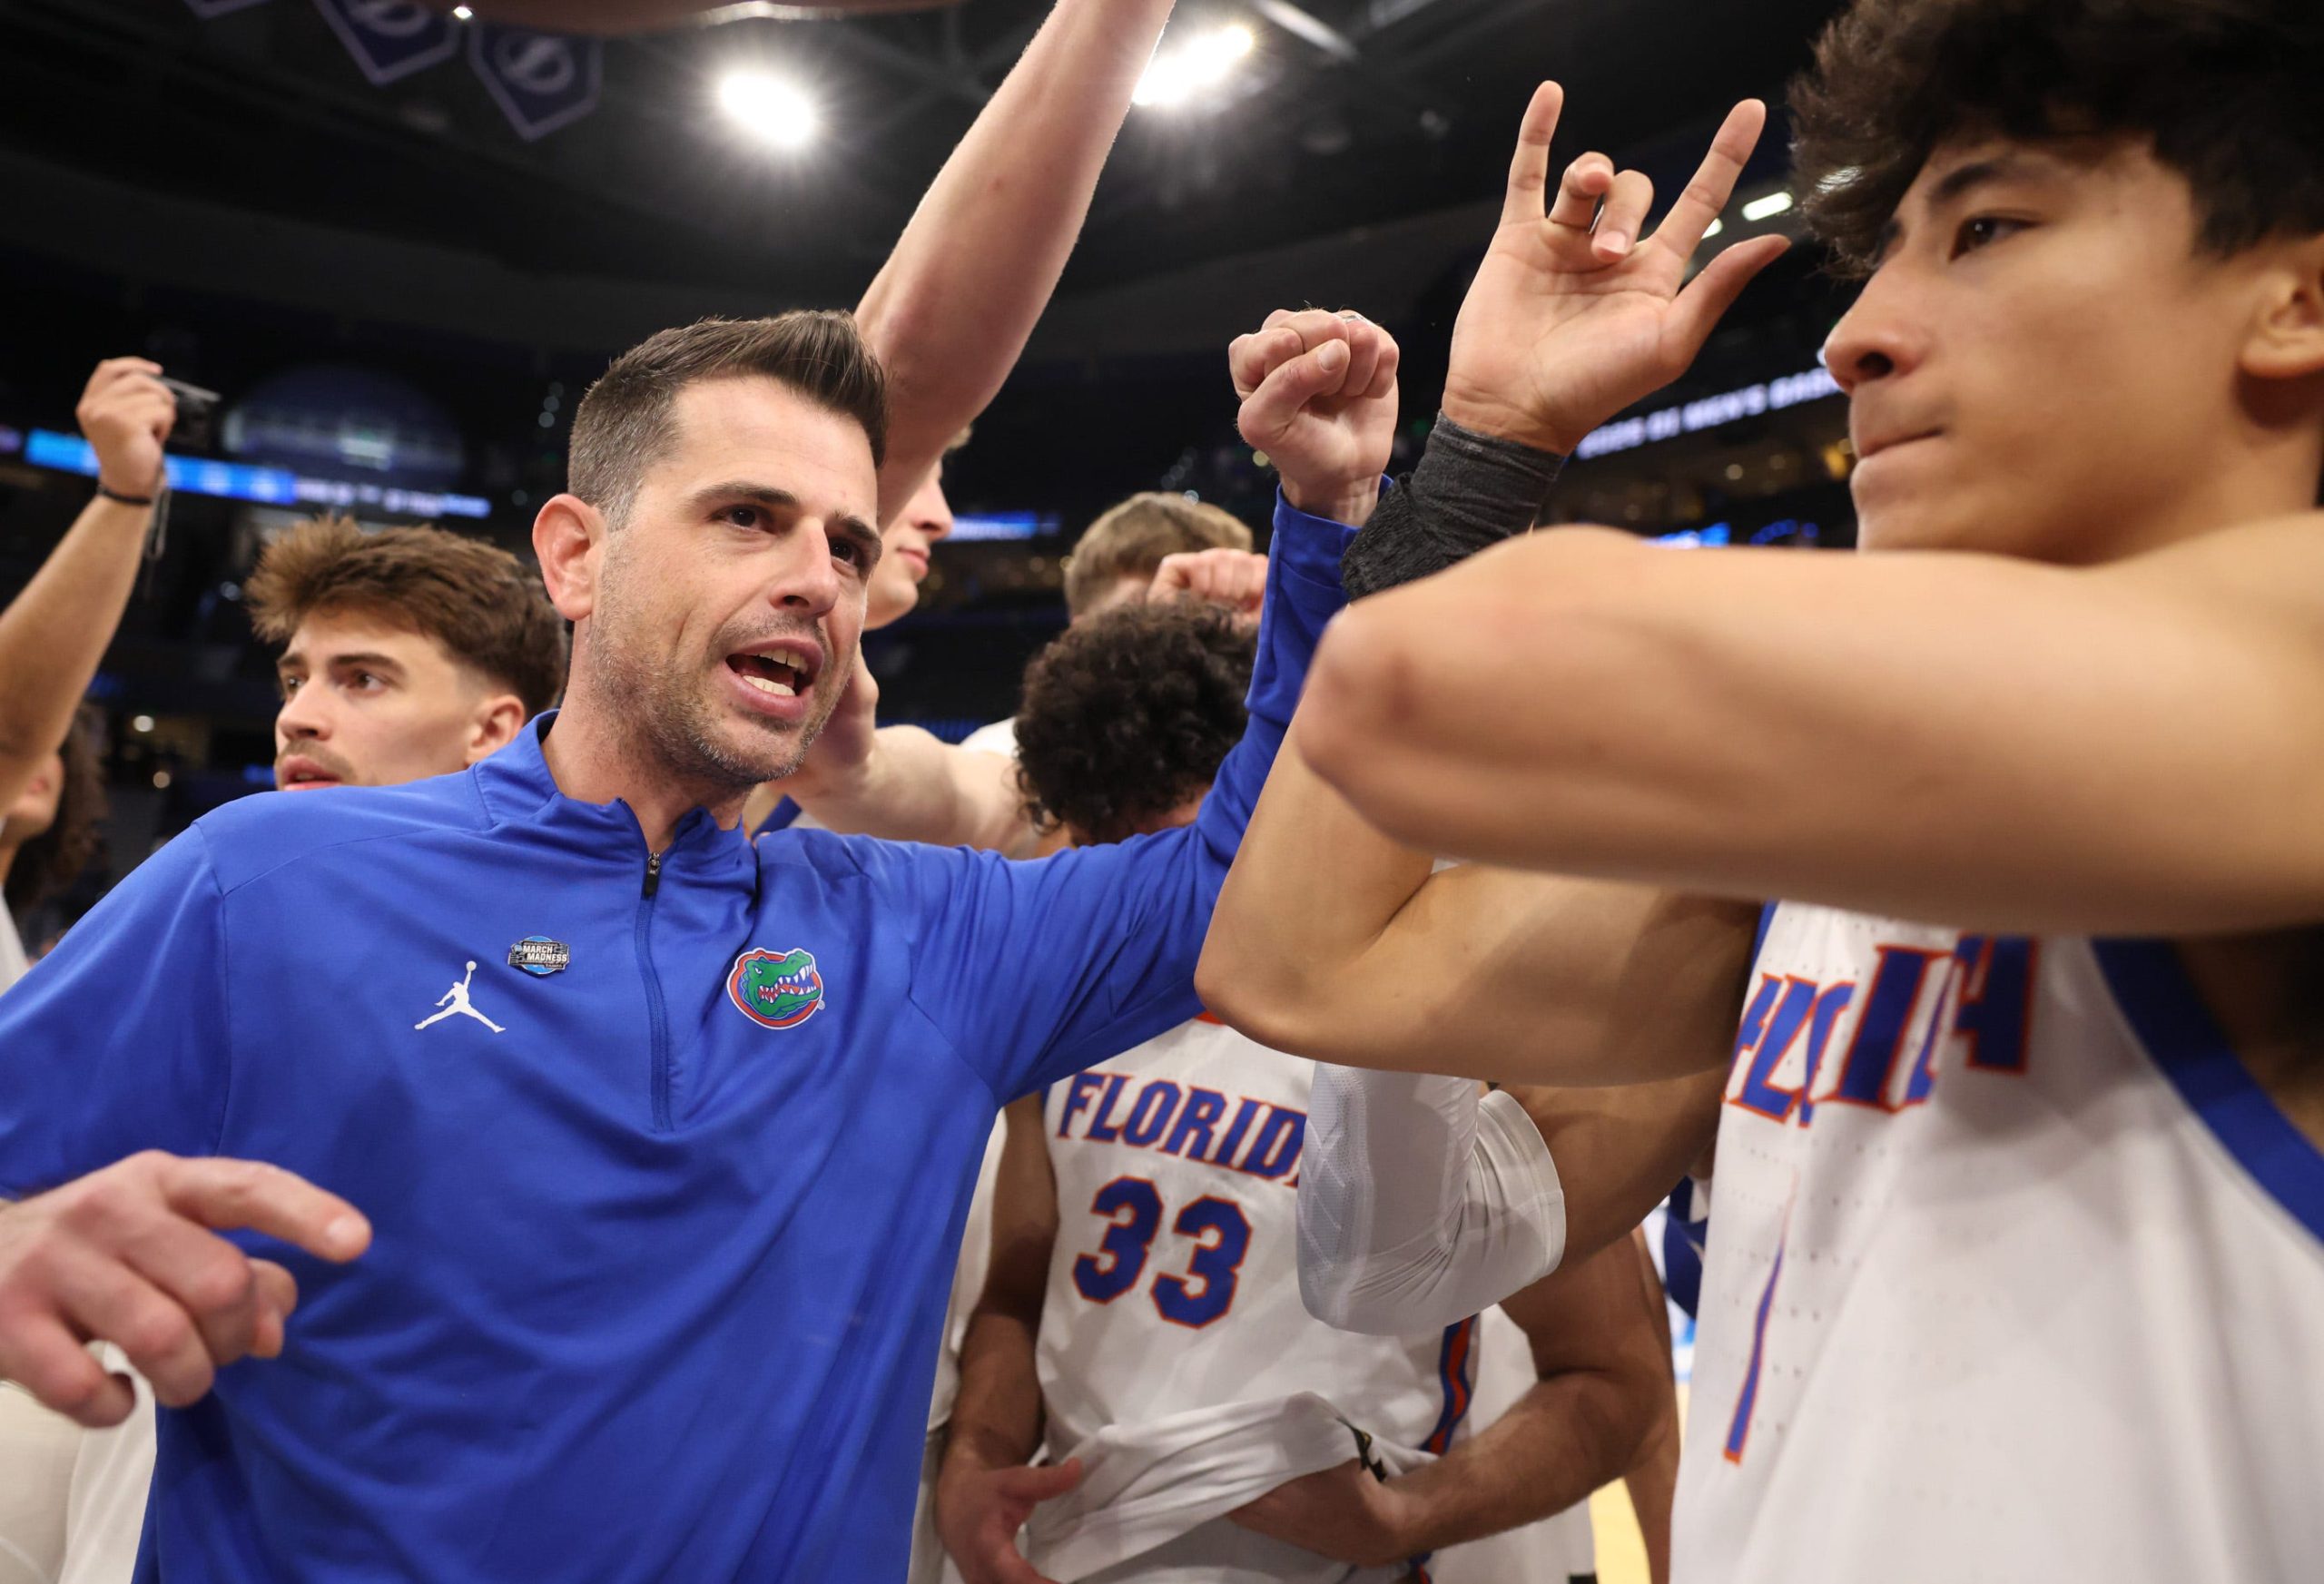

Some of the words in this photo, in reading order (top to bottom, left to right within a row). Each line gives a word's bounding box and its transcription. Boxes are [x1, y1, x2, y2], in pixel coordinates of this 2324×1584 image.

[523, 946, 553, 954] MARCH
[527, 953, 567, 962] MADNESS
[1056, 1069, 1307, 1188] FLORID
[1072, 1175, 1253, 1330] 33
